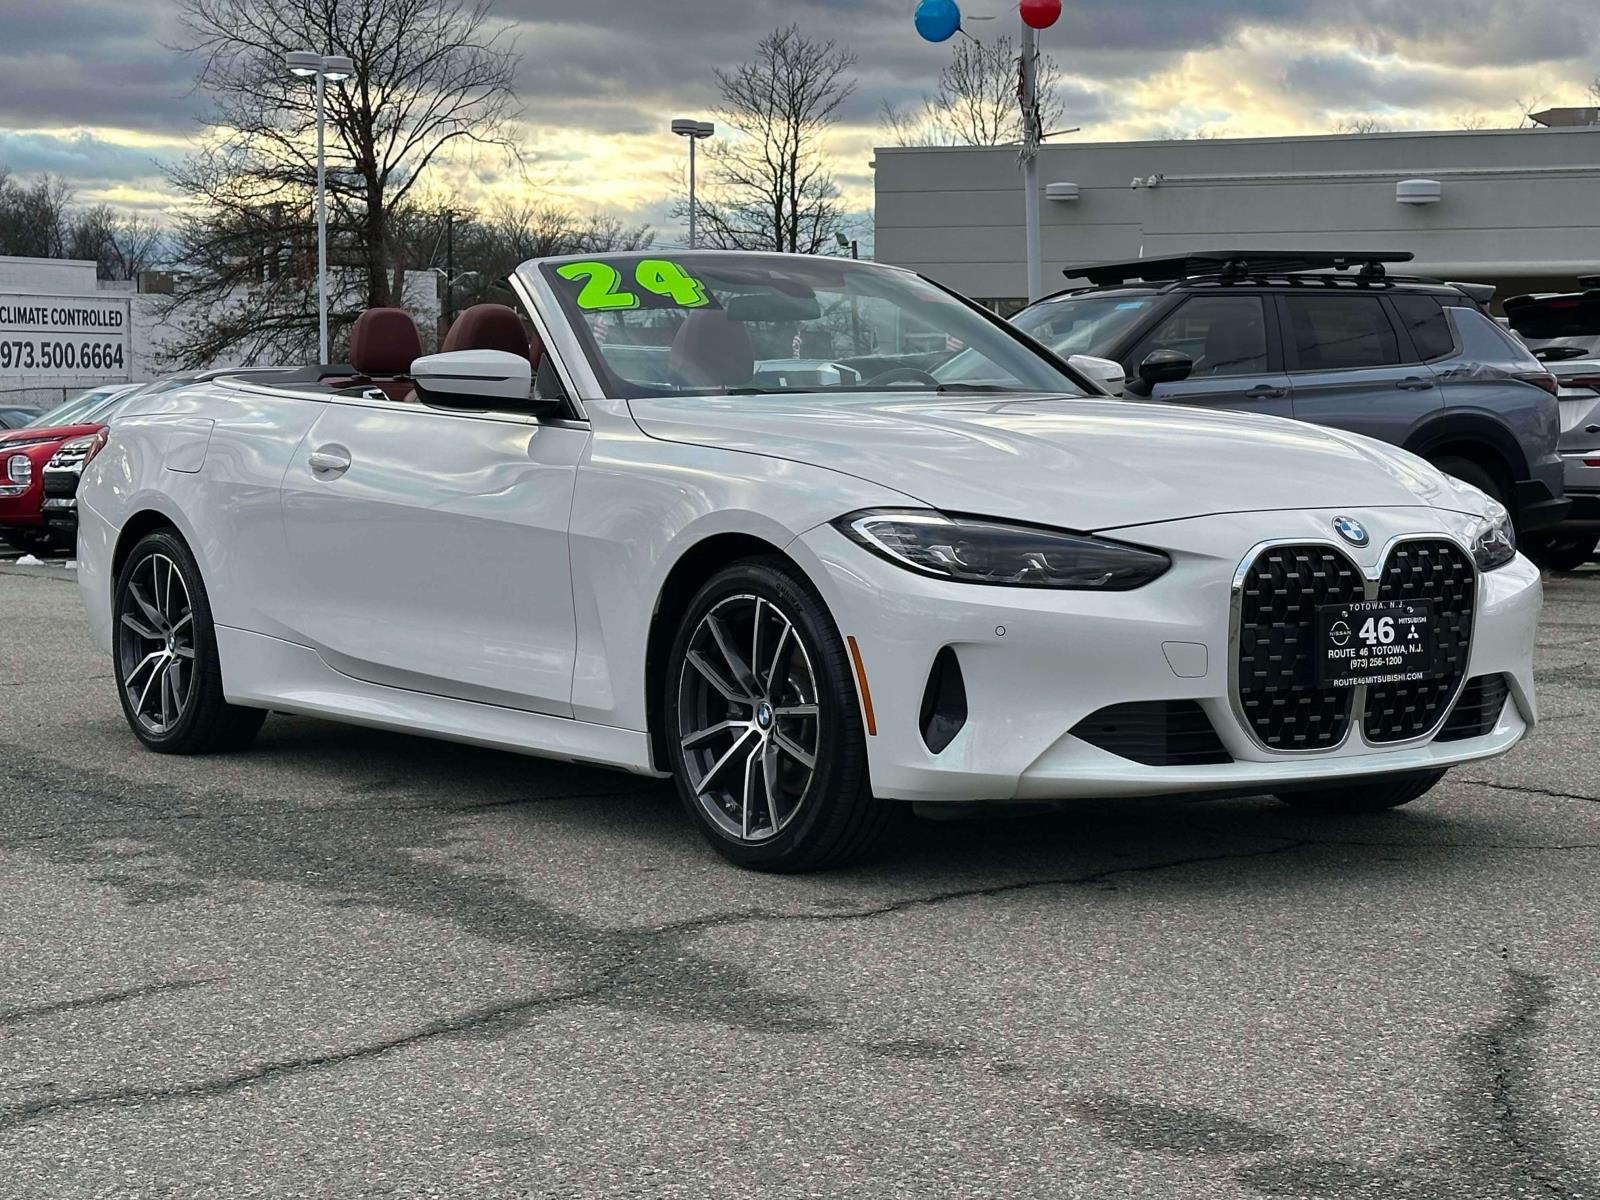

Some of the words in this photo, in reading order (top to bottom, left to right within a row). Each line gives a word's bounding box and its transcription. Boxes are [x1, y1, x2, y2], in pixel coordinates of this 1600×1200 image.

[556, 259, 709, 310] 24
[0, 306, 48, 325] CLIMATE
[51, 308, 122, 327] CONTROLLED
[0, 341, 123, 369] 973.500.6664
[1359, 616, 1395, 645] 46
[1328, 648, 1356, 659] ROUTE
[1359, 648, 1369, 656] 46
[1372, 646, 1408, 655] TOTOWA,
[1409, 643, 1423, 653] N.J.
[1350, 659, 1368, 670] (973)
[1369, 656, 1402, 667] 256-1200
[1333, 672, 1423, 687] ROUTE46MITSUBISHI.COM
